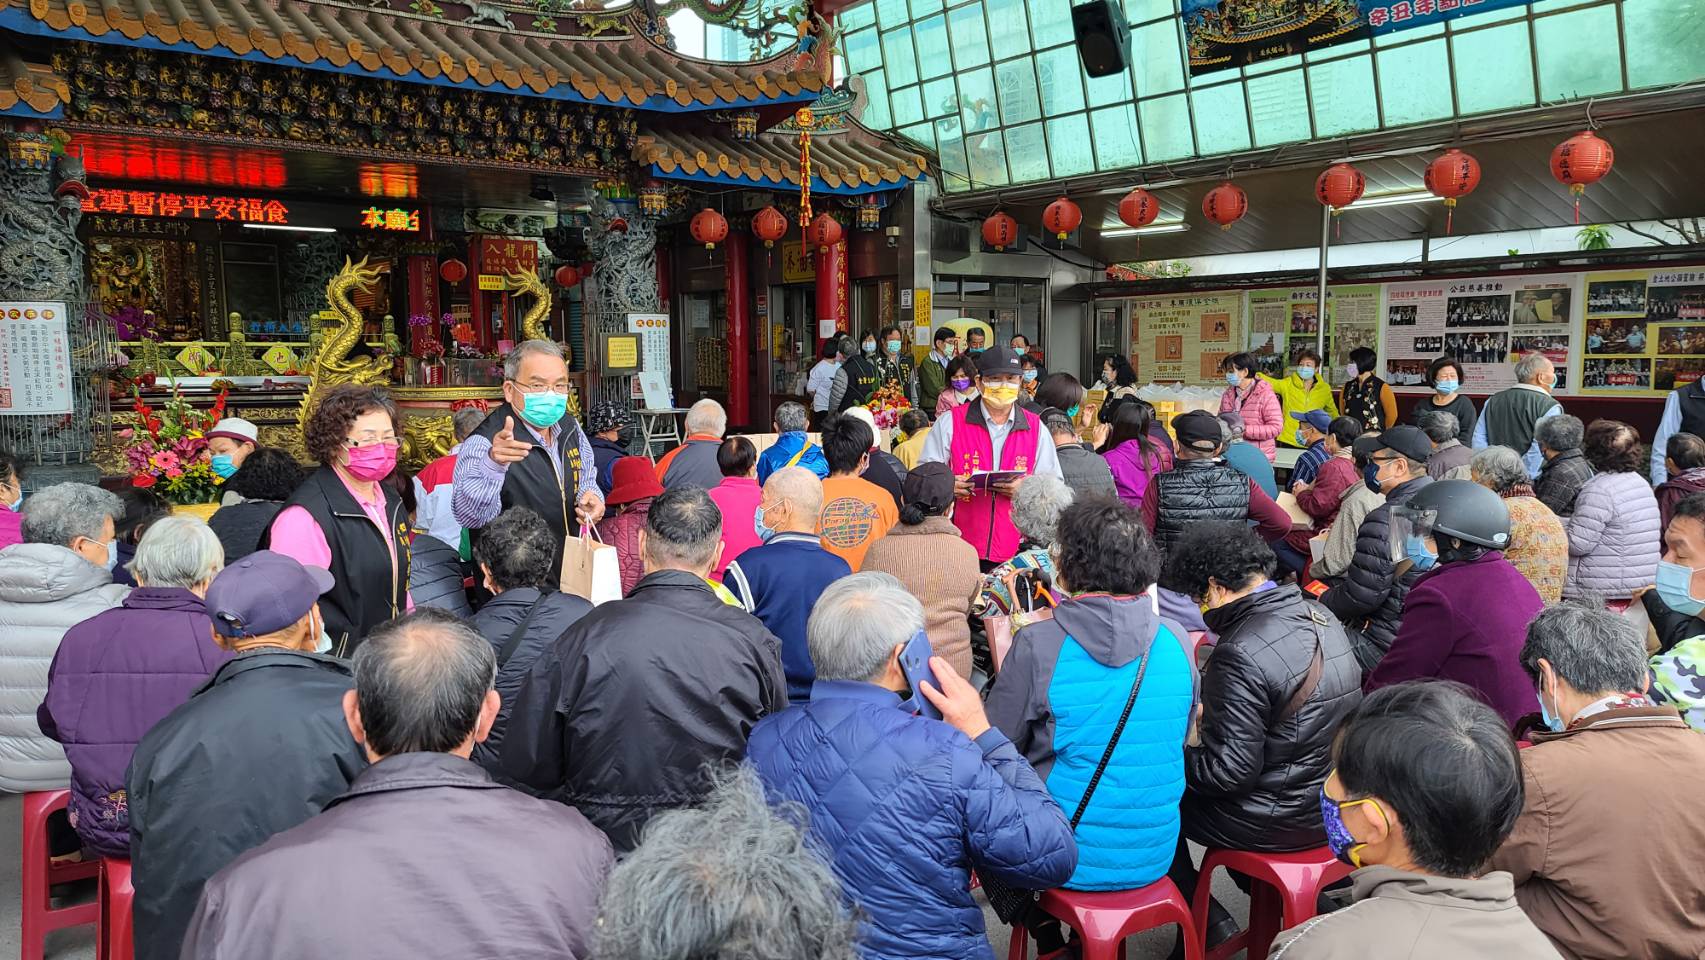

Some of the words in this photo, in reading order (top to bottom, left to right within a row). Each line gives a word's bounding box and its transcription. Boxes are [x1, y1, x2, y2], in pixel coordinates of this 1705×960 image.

[486, 243, 534, 259] 入龍門
[1450, 283, 1503, 293] 公益慈善推動
[1291, 291, 1333, 300] 廟宇文化承
